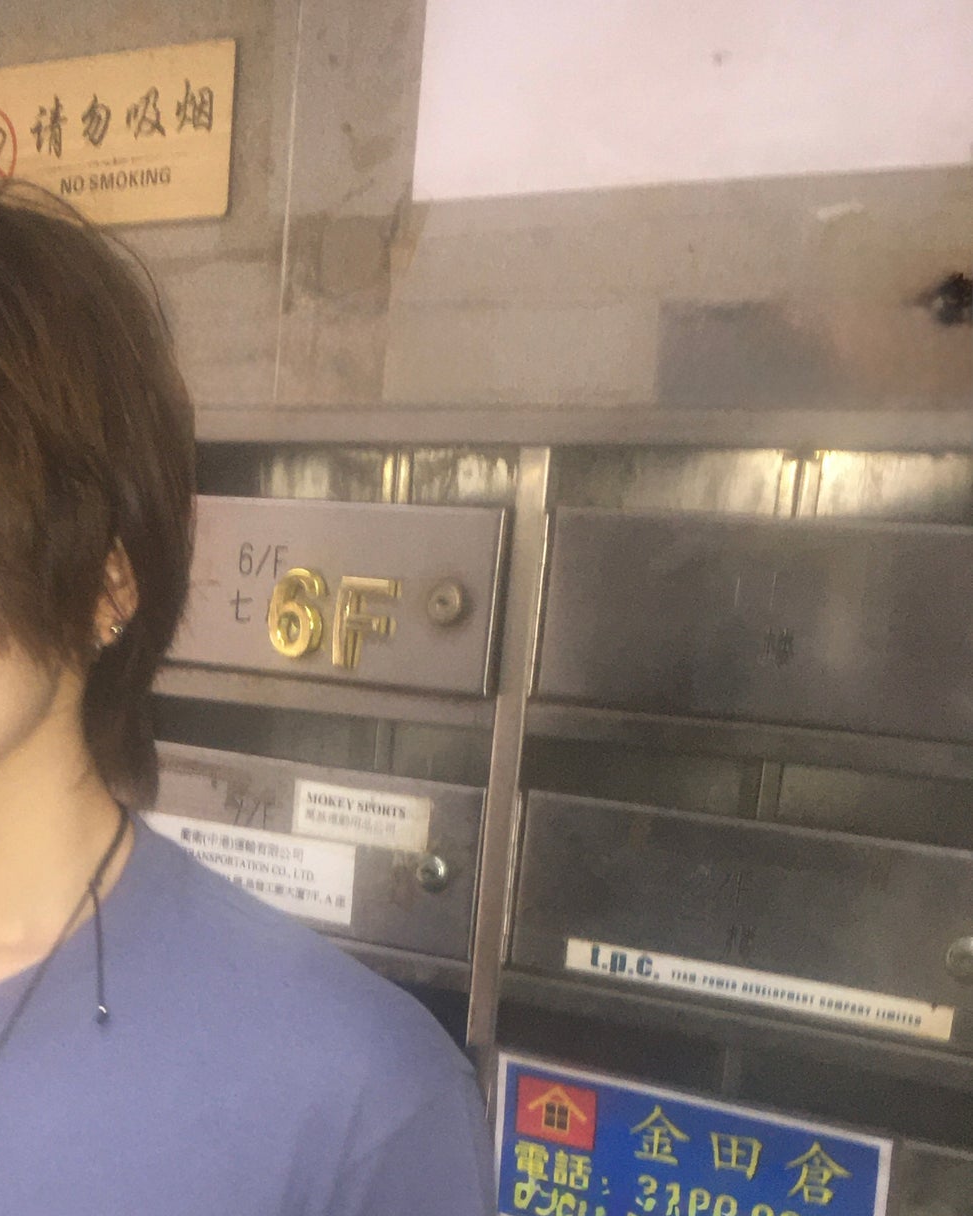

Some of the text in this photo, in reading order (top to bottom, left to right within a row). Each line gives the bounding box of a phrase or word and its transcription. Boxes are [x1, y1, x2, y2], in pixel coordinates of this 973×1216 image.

[30, 78, 214, 159] 请勿吸烟
[60, 167, 172, 195] NO SMOKING
[238, 542, 288, 579] 6/F
[268, 567, 402, 670] 6F
[187, 848, 270, 874] RANSPORTATION
[631, 1104, 852, 1206] 金田倉
